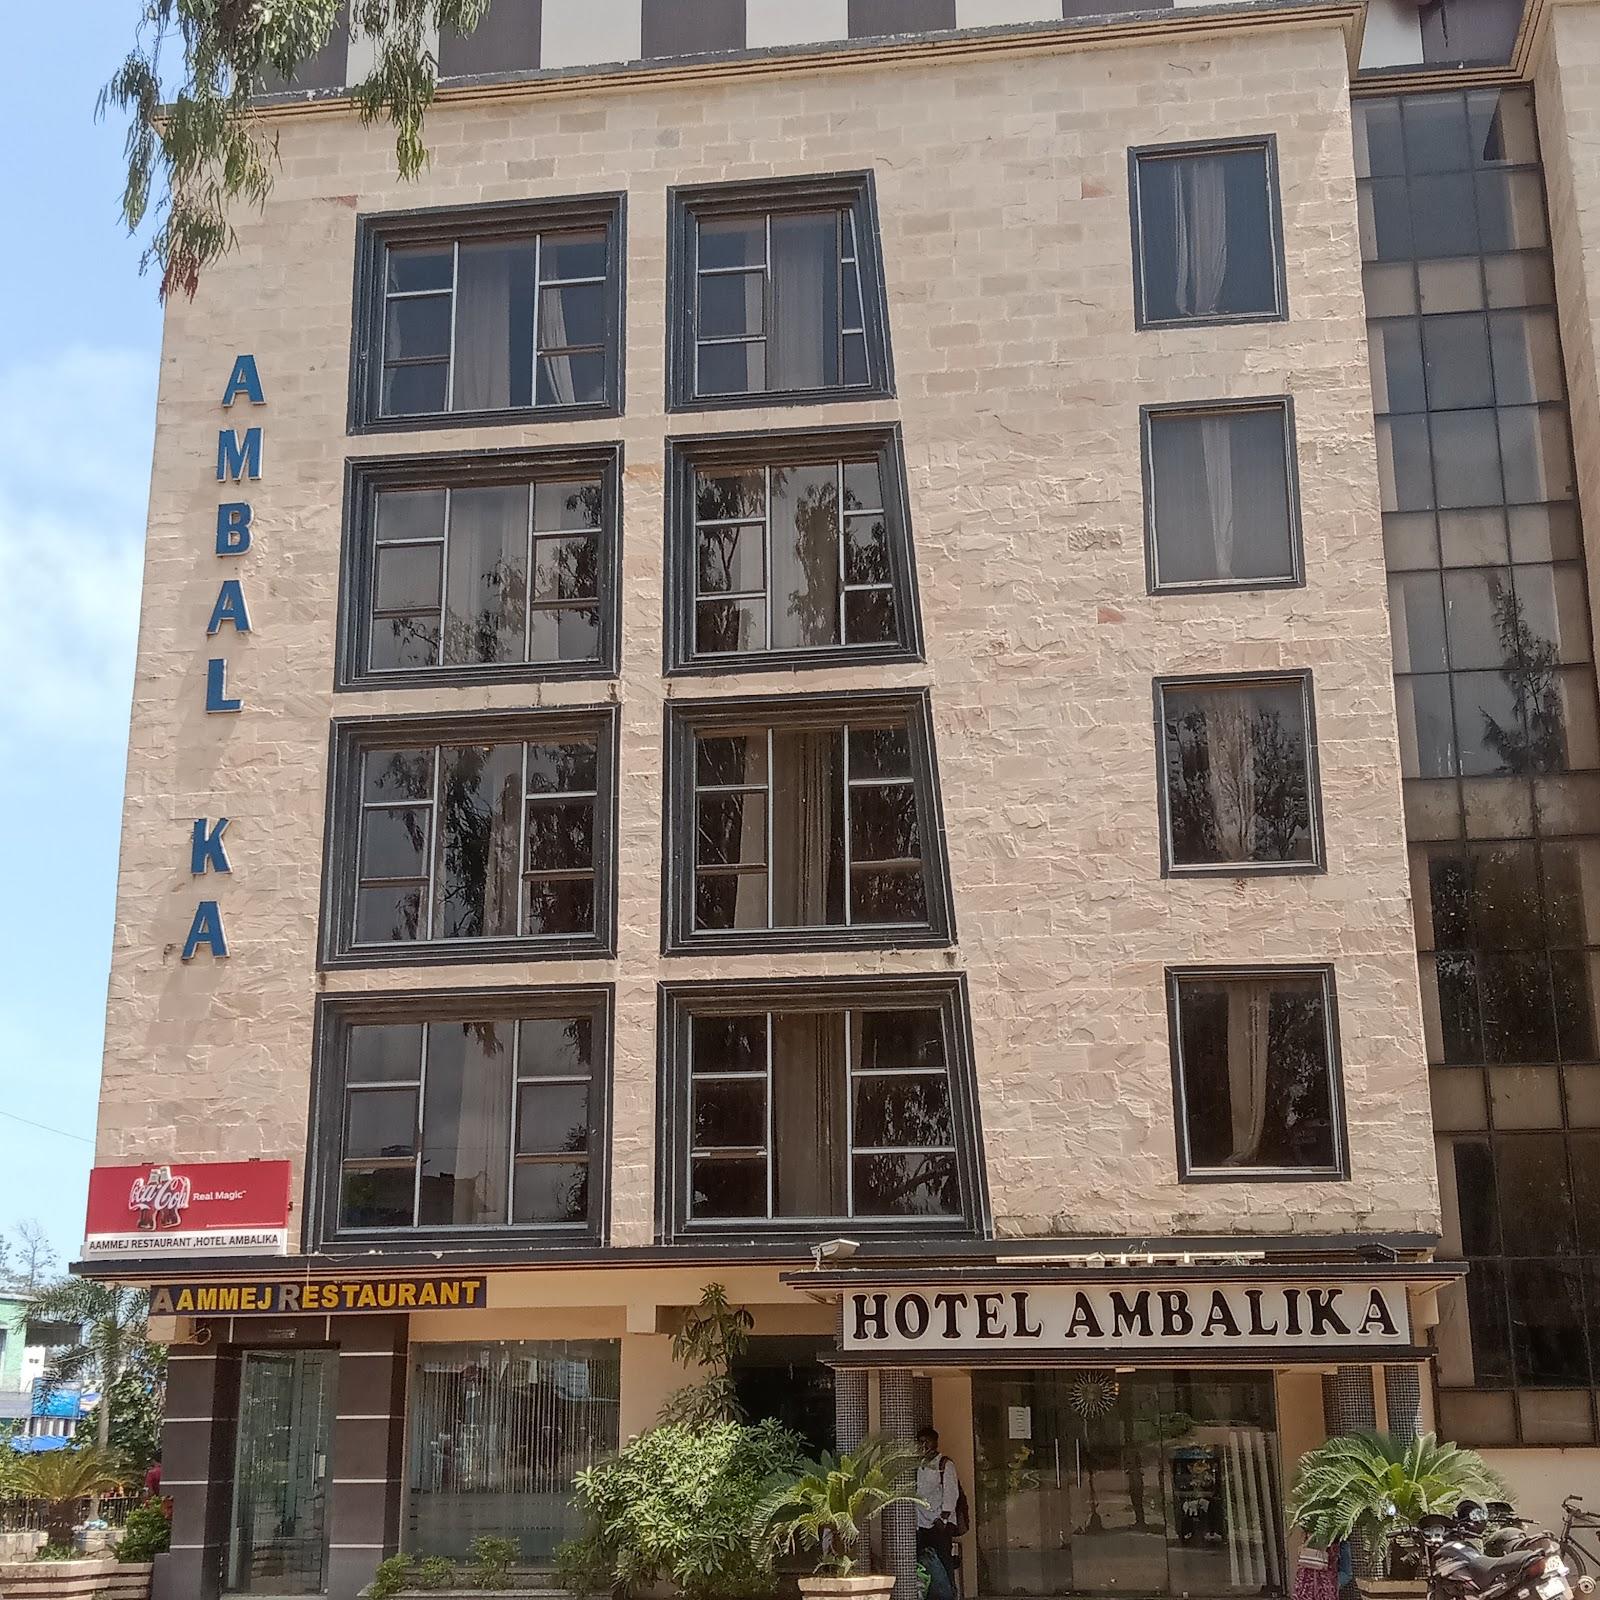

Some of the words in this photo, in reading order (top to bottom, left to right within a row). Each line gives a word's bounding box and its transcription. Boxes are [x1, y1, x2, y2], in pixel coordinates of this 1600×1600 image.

[192, 1192, 214, 1201] Real
[89, 1240, 129, 1250] AAMMEJ
[131, 1238, 191, 1249] RESTAURANT
[229, 1234, 278, 1246] AMBALIKA
[151, 1286, 273, 1314] AAMMEJ
[279, 1280, 480, 1312] RESTAURANT
[852, 1291, 1042, 1340] HOTEL
[1064, 1288, 1401, 1338] AMBALIKA
